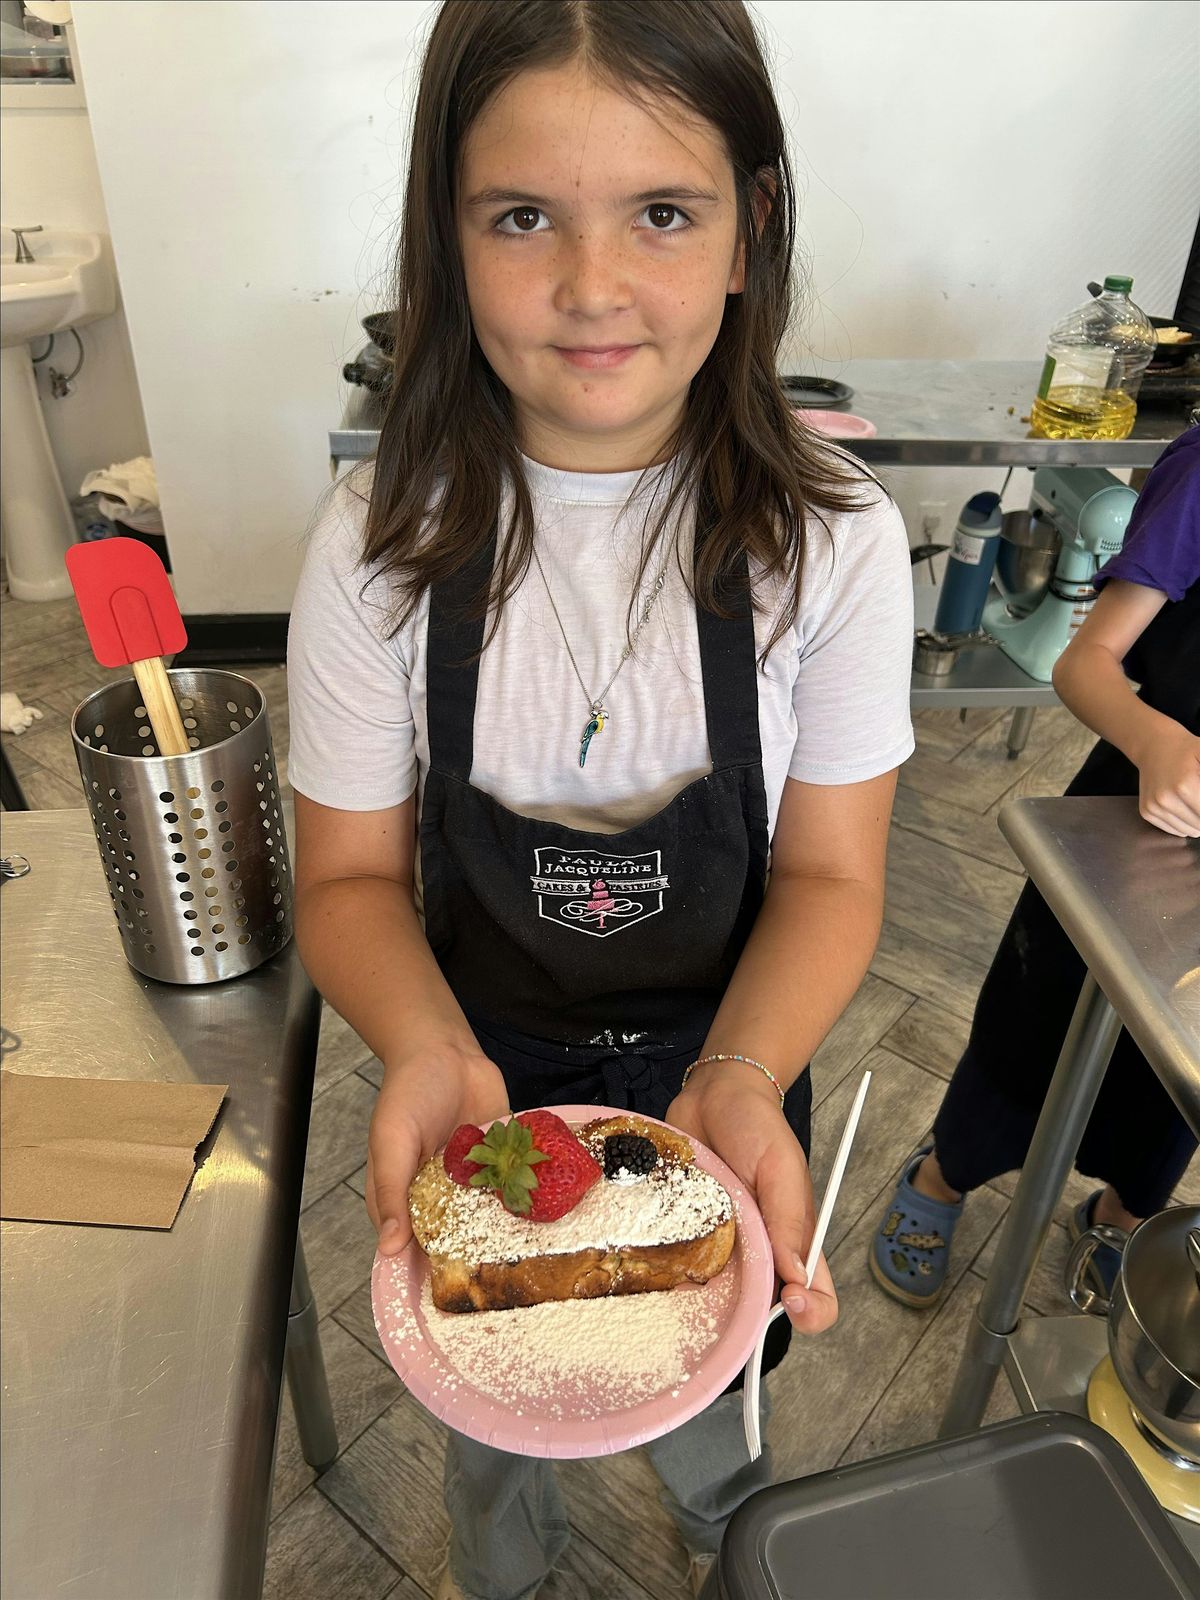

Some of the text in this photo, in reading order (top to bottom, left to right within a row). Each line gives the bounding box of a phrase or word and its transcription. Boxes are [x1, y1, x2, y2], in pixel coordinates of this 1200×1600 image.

[559, 855, 635, 867] PAULA
[544, 863, 652, 876] JACQUELINE
[537, 881, 574, 892] CAKES
[576, 883, 586, 892] &
